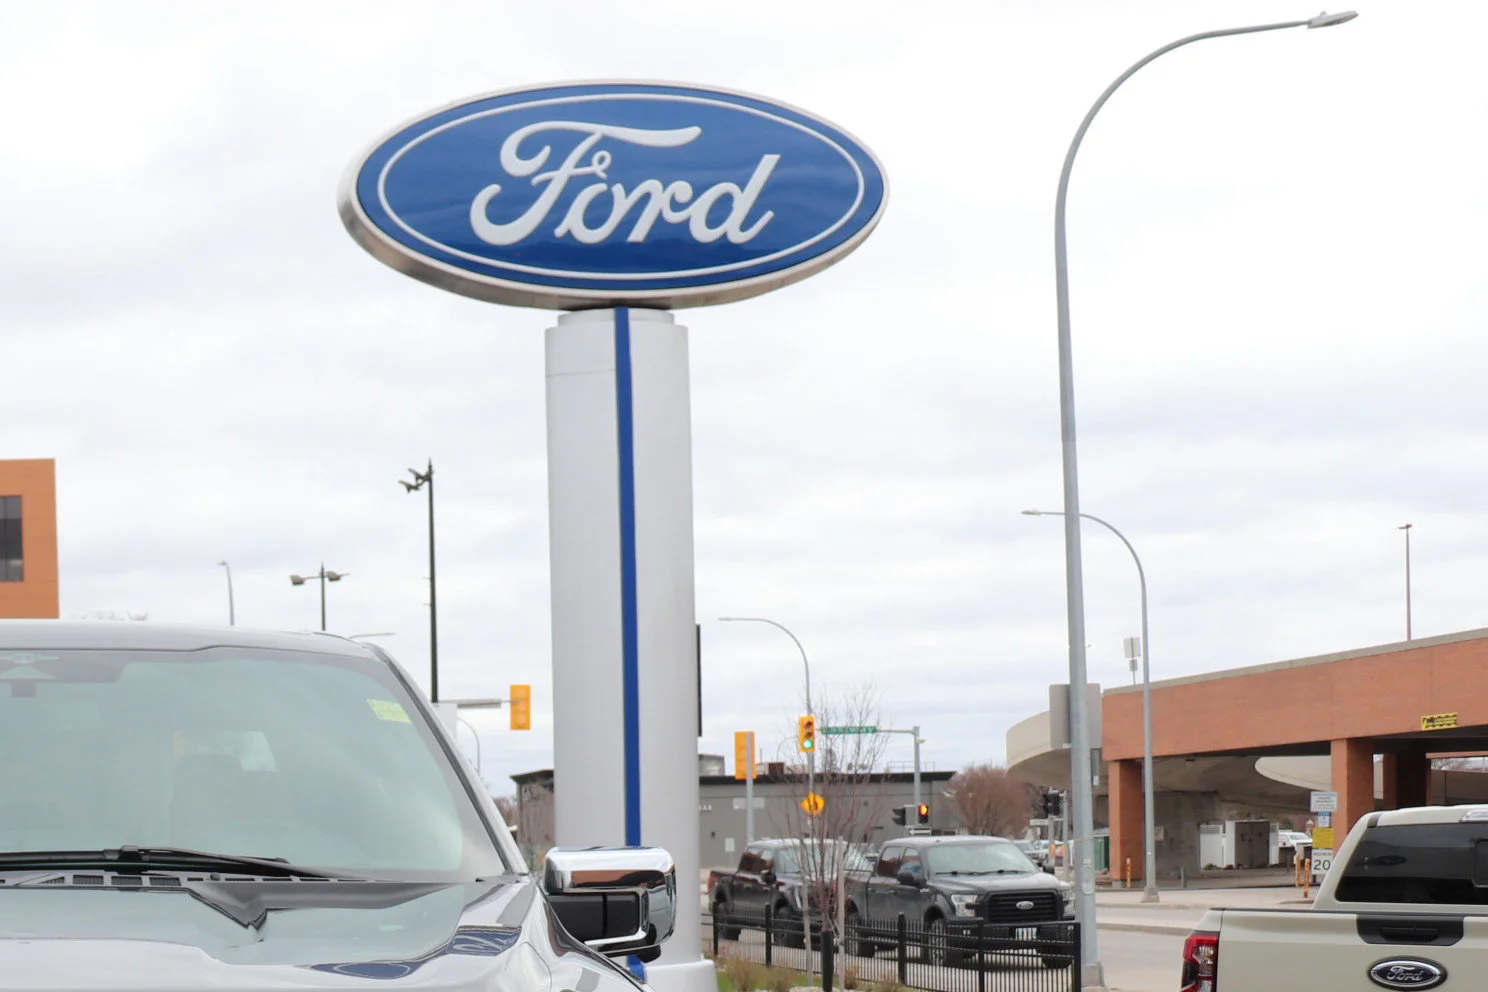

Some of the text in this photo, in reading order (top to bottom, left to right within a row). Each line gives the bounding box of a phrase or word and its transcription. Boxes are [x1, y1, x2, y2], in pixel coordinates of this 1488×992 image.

[470, 121, 780, 245] Ford
[1314, 859, 1331, 871] 20
[1386, 966, 1424, 981] Ford
